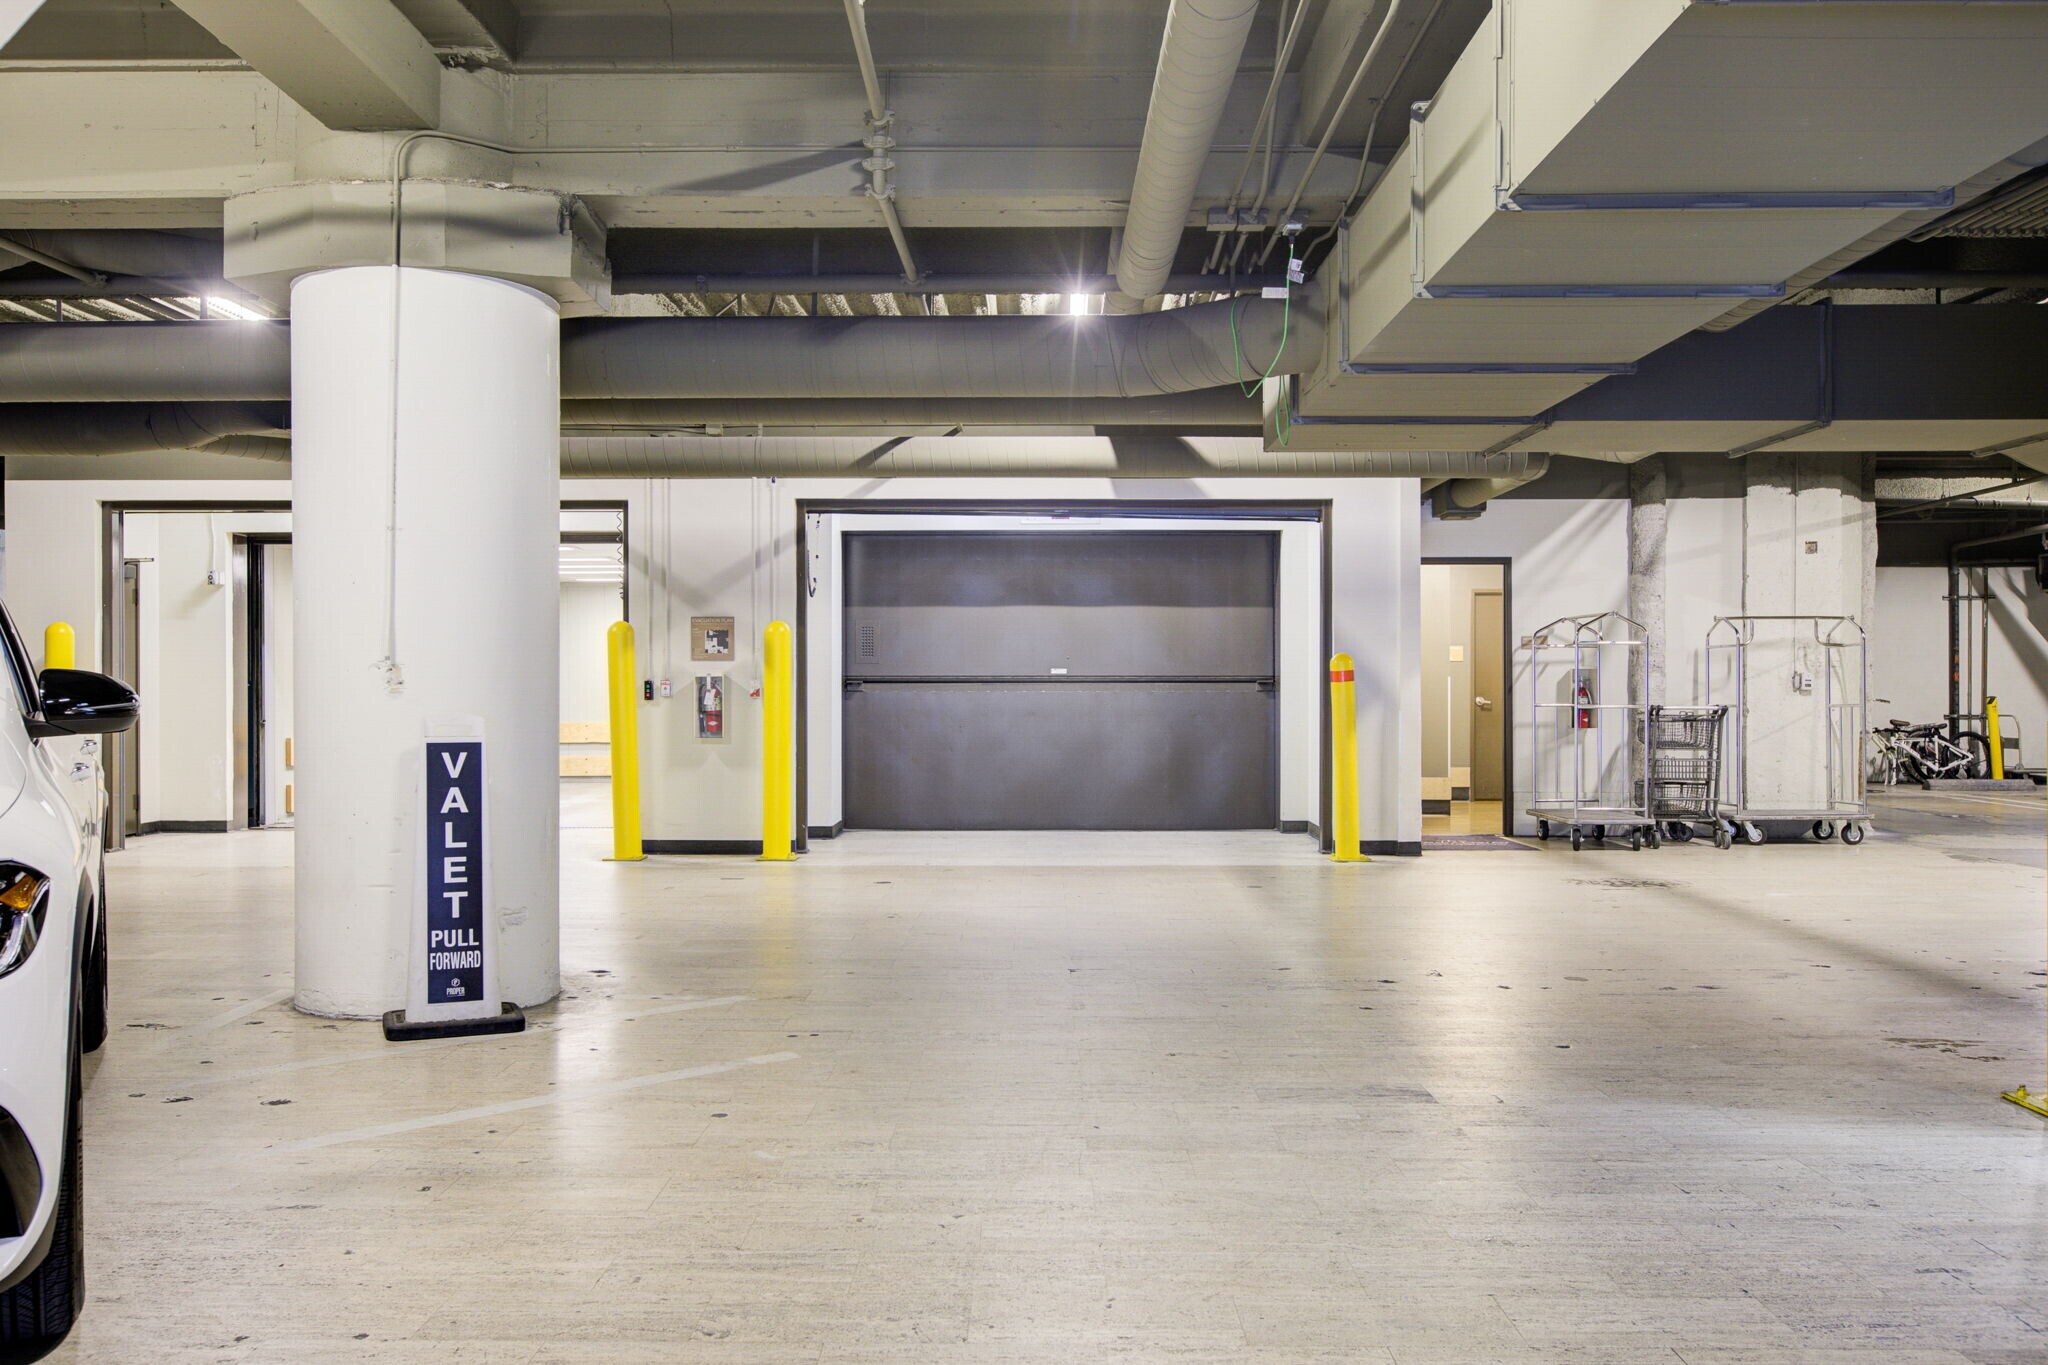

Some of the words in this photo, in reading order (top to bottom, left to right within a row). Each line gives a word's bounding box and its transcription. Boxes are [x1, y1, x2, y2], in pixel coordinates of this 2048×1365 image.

[440, 751, 469, 919] VALET
[431, 928, 480, 948] PULL
[430, 950, 481, 971] FORWARD
[446, 986, 465, 995] PROPER
